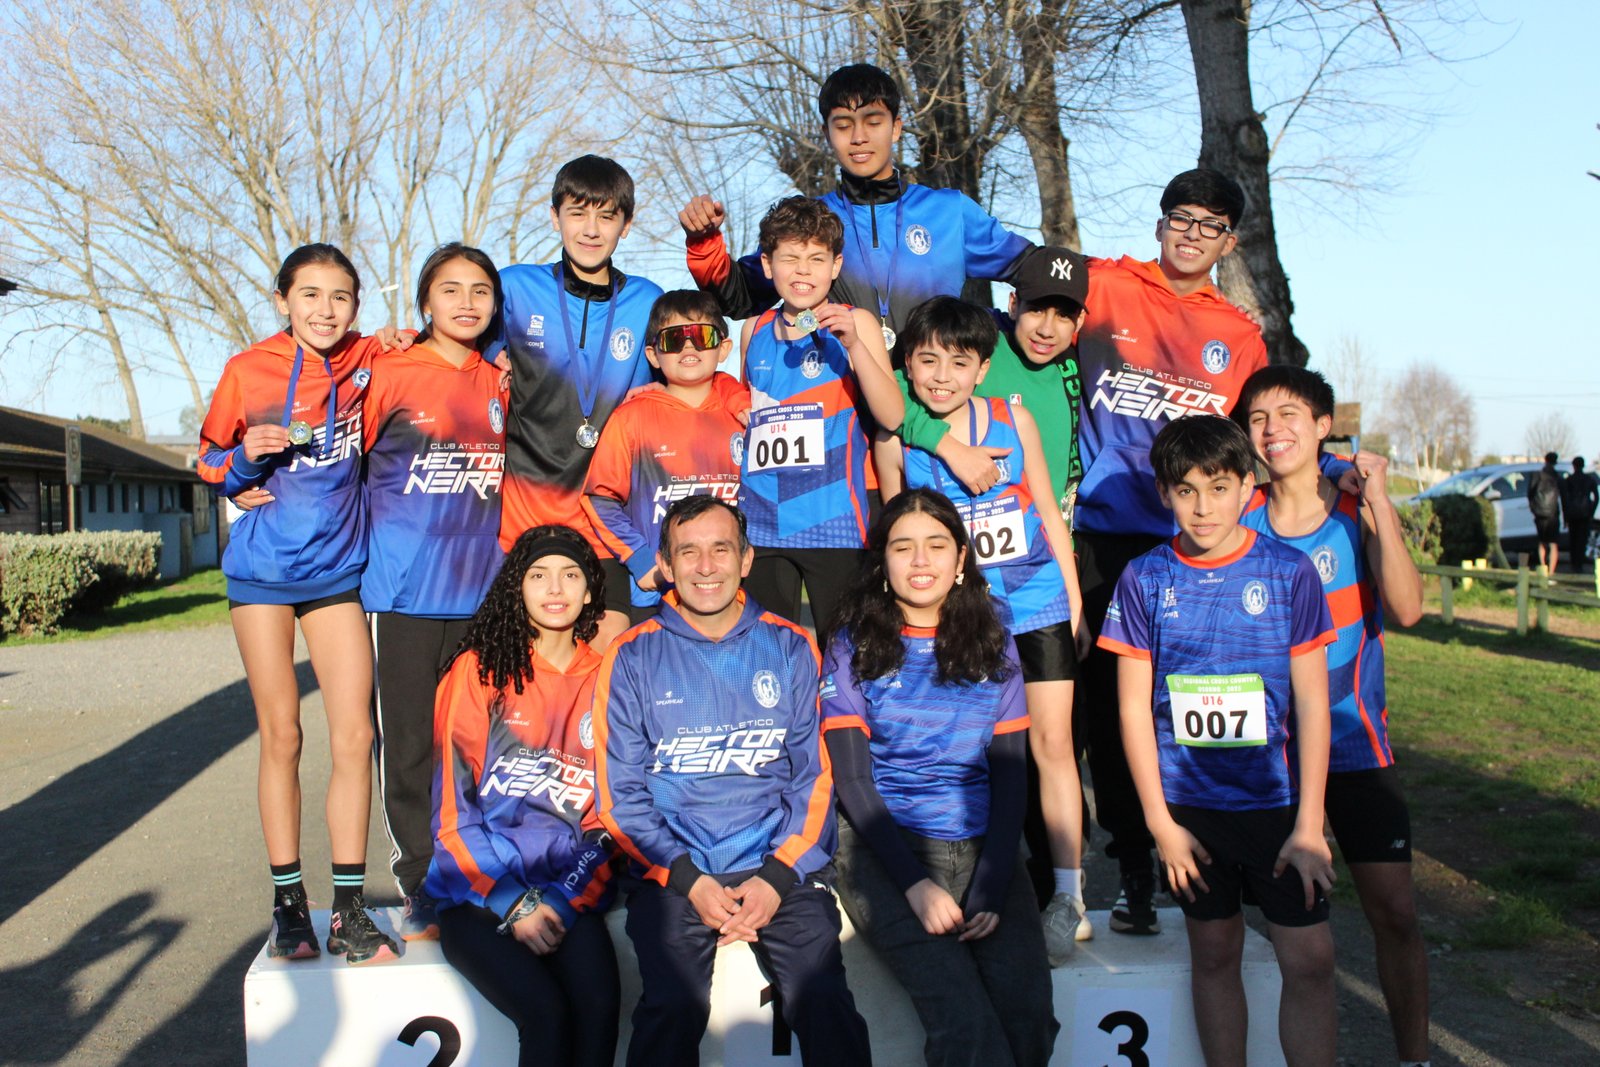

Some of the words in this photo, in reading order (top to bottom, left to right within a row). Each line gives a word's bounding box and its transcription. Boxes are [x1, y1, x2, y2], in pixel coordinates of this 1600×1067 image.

[1050, 257, 1073, 281] NY
[1122, 362, 1154, 375] CLUB
[1155, 371, 1212, 390] ATLETICO
[1095, 369, 1229, 417] HECTOR
[777, 405, 793, 413] CROSS
[793, 404, 818, 412] COUNTRY
[770, 423, 787, 434] U14
[430, 442, 456, 450] CLUB
[756, 435, 811, 468] 001
[408, 452, 506, 471] HECTOR
[403, 471, 504, 500] NEIRA
[653, 483, 741, 502] HECTO
[975, 526, 1016, 559] 02
[655, 698, 684, 706] SPEARHEAD
[1202, 695, 1223, 706] U16
[677, 726, 713, 735] CLUB
[715, 717, 775, 734] ATLETICO
[1184, 709, 1249, 740] 007
[654, 727, 788, 756] HECTOR
[489, 755, 595, 790] HECTOR
[397, 1015, 462, 1067] 2
[1097, 1010, 1150, 1067] 3
